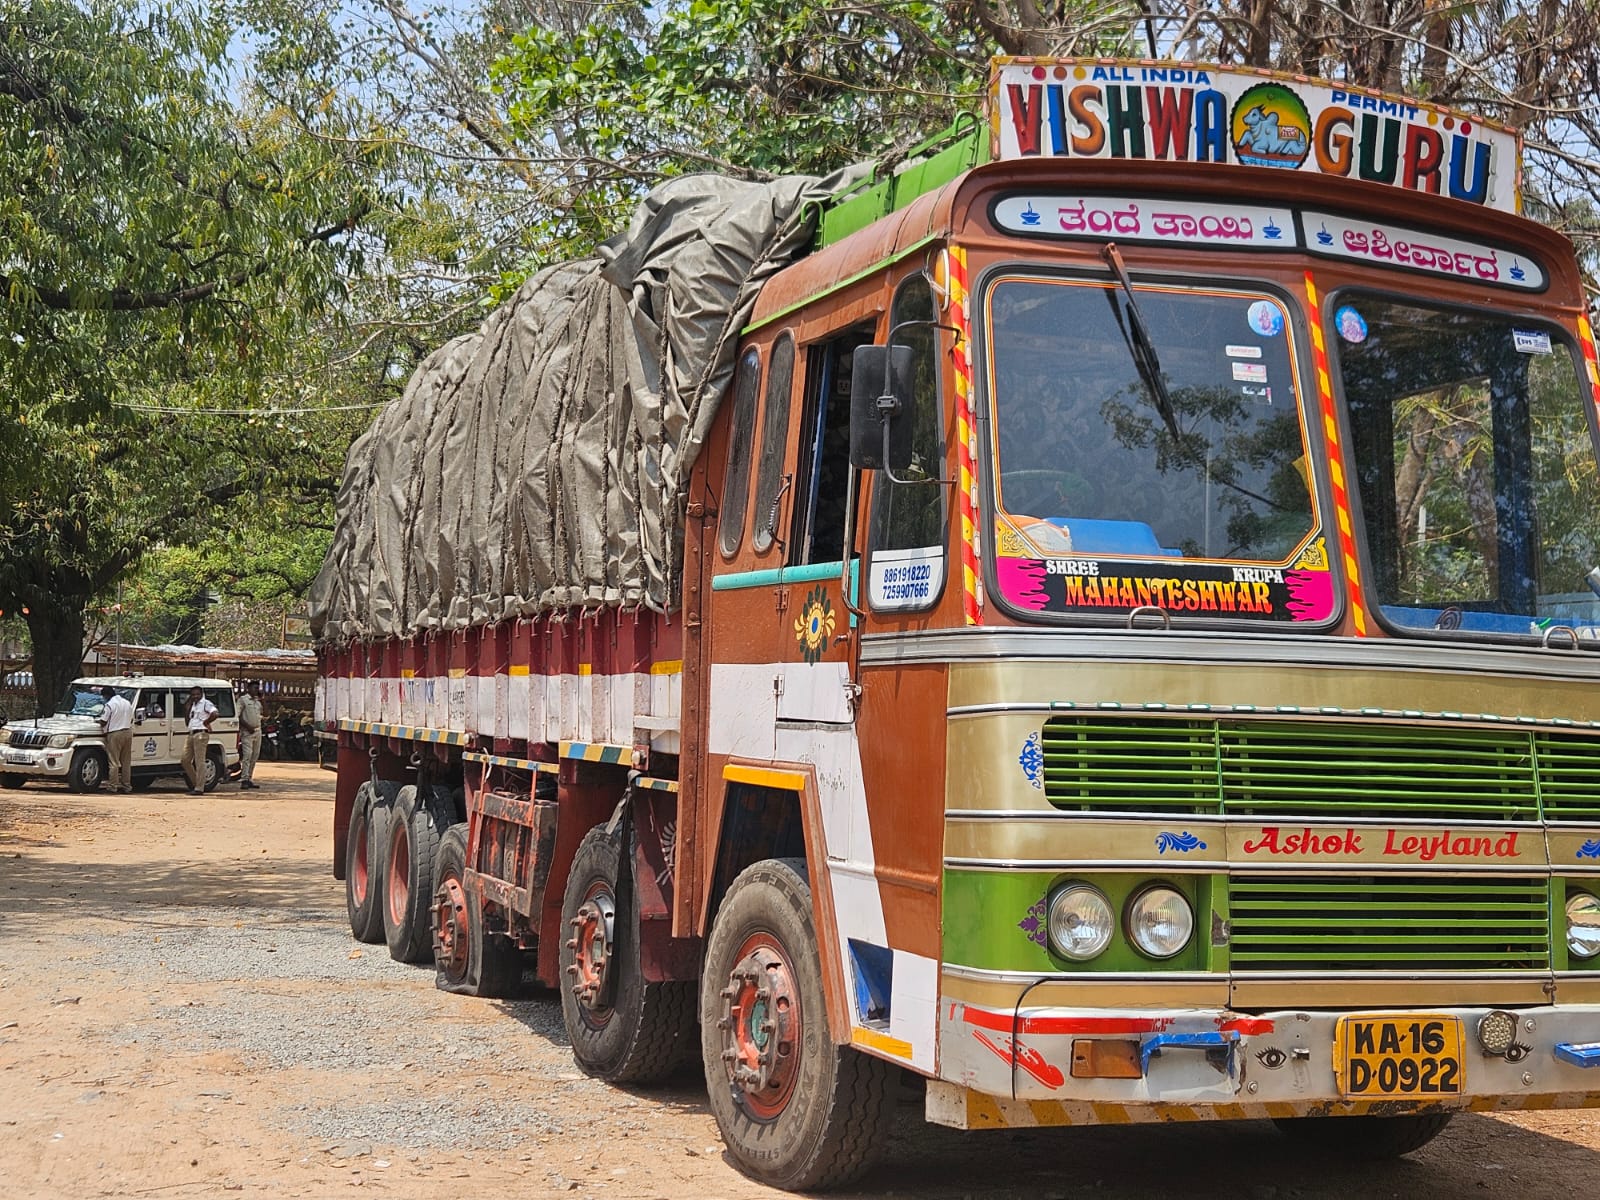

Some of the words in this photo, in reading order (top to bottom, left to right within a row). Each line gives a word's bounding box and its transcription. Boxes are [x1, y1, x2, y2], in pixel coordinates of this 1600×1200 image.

[1092, 66, 1134, 81] ALL
[1141, 68, 1211, 85] INDIA
[1331, 90, 1419, 120] PERMIT
[1007, 84, 1228, 163] VISHWA
[1314, 106, 1492, 205] GURU
[1058, 199, 1141, 235] ತಂದೆ
[1152, 212, 1254, 241] ತಾಯಿ
[1342, 229, 1499, 281] ಆಶೀರ್ವಾದ
[882, 582, 930, 600] 7259907666
[883, 564, 931, 583] 8861918220
[1046, 559, 1100, 576] SHREE
[1232, 567, 1285, 585] KRUPA
[1065, 575, 1274, 614] MAHANTESHWAR
[1243, 827, 1366, 855] Ashok
[1382, 829, 1522, 861] Leyland
